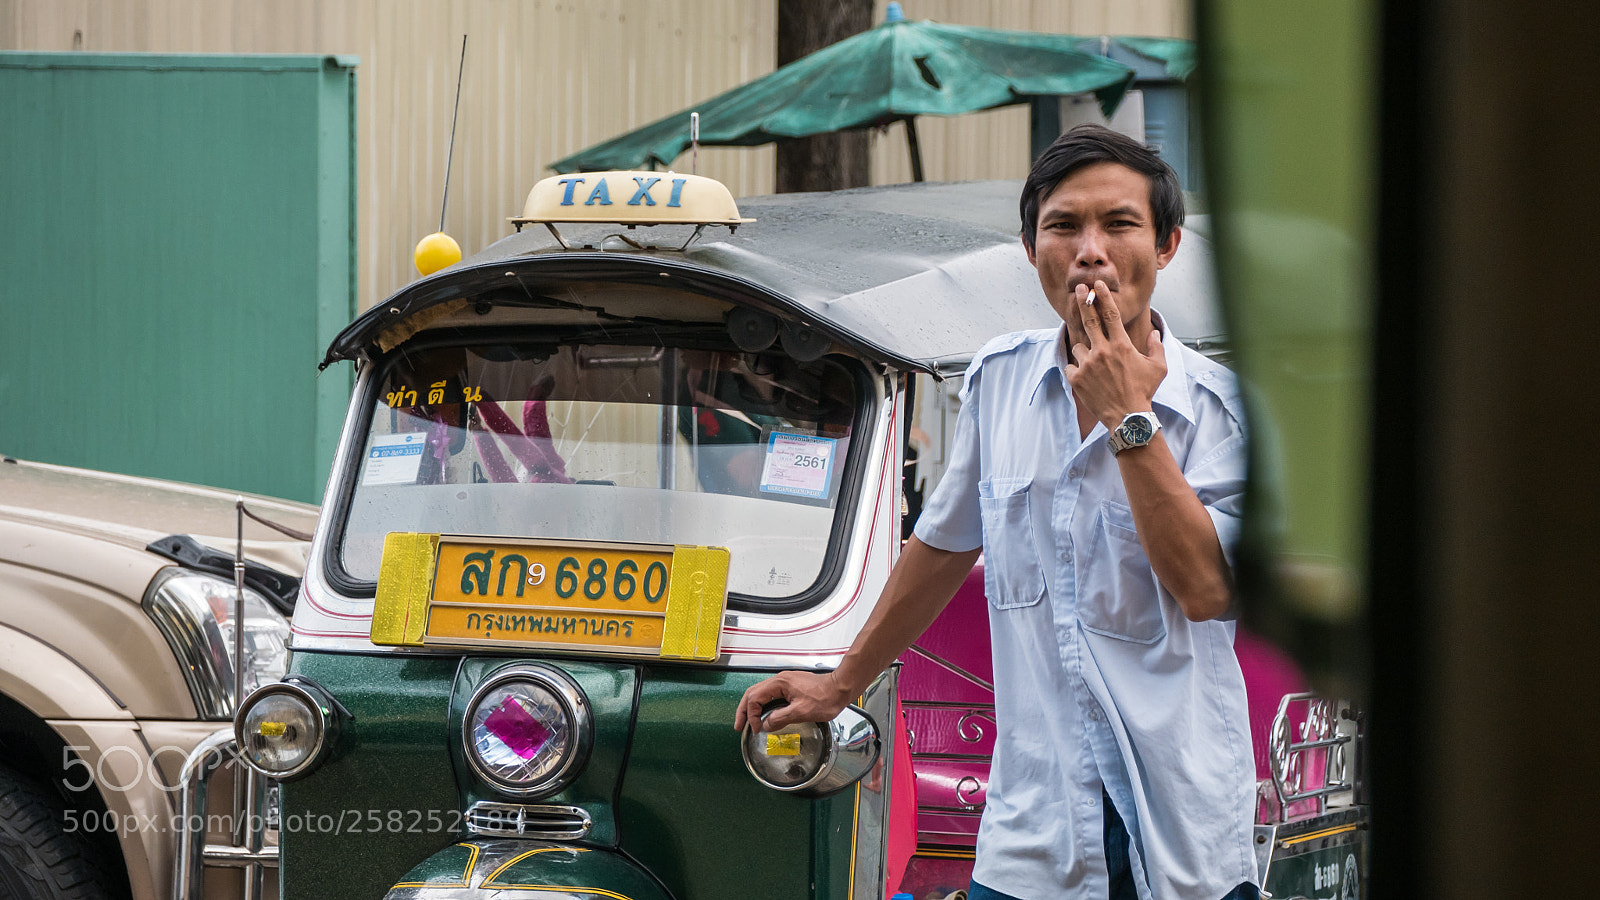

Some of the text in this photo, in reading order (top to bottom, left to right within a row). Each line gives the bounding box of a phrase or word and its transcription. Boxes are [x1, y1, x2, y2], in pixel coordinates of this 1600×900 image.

[558, 177, 686, 208] TAXI
[793, 454, 827, 470] 2561
[460, 549, 668, 604] สก 9 6860
[466, 612, 635, 638] กรุงเทพมหานคร
